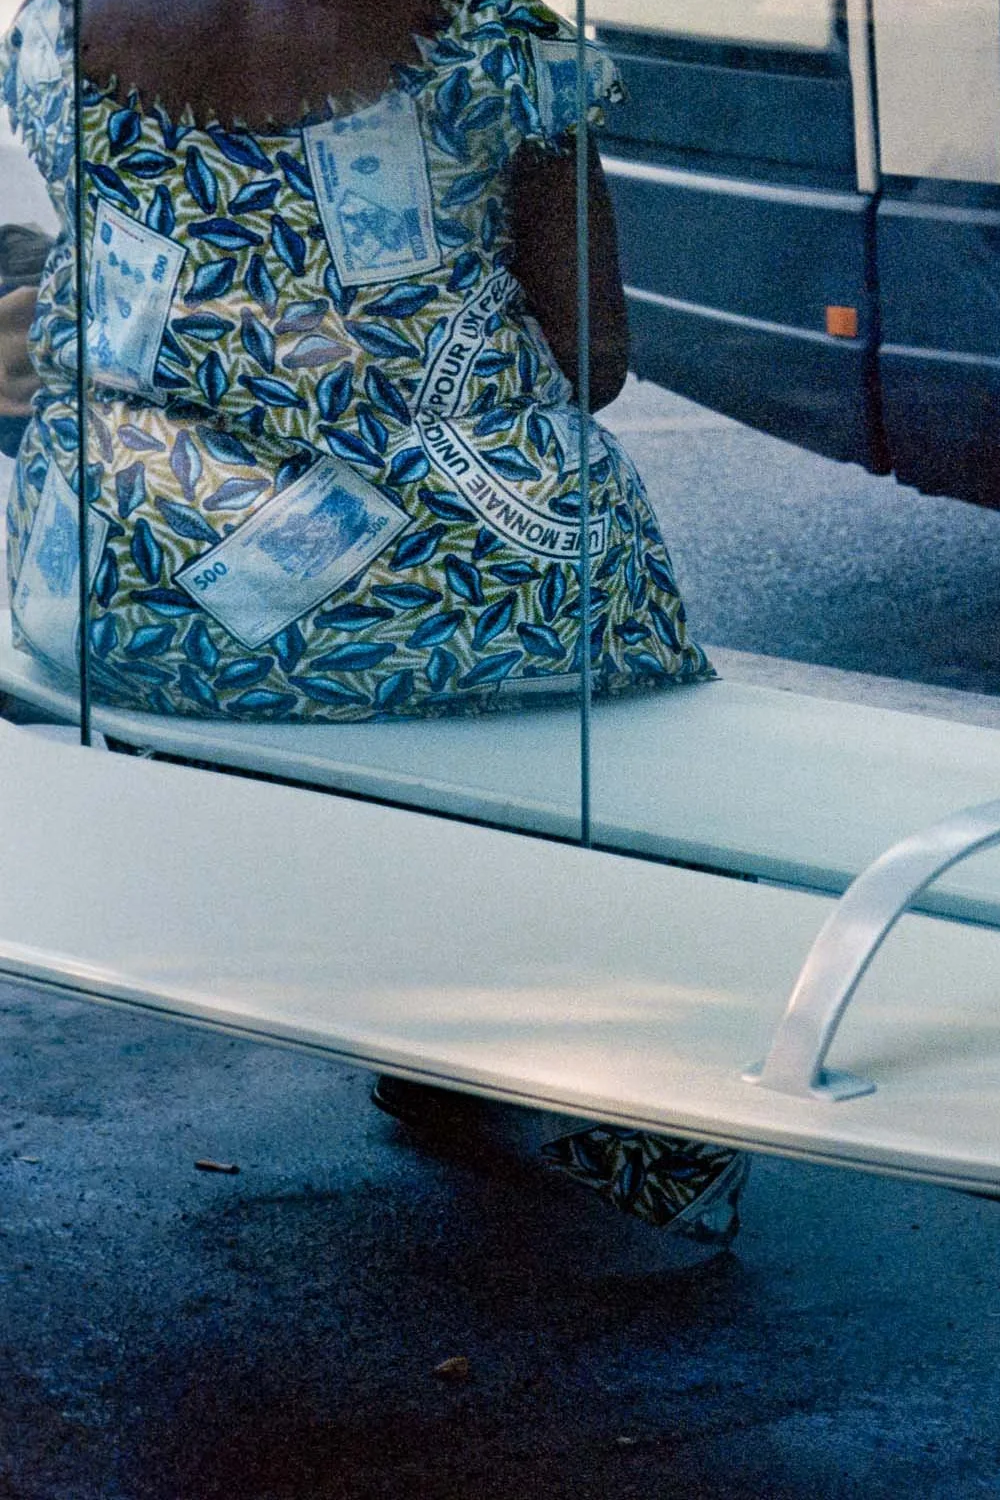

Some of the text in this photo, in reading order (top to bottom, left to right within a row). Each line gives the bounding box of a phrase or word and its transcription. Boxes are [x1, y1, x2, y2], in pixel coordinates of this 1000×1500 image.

[431, 343, 471, 406] POUR
[421, 410, 470, 477] UNIQU
[466, 476, 559, 548] MONNAIE
[193, 561, 228, 592] 500
